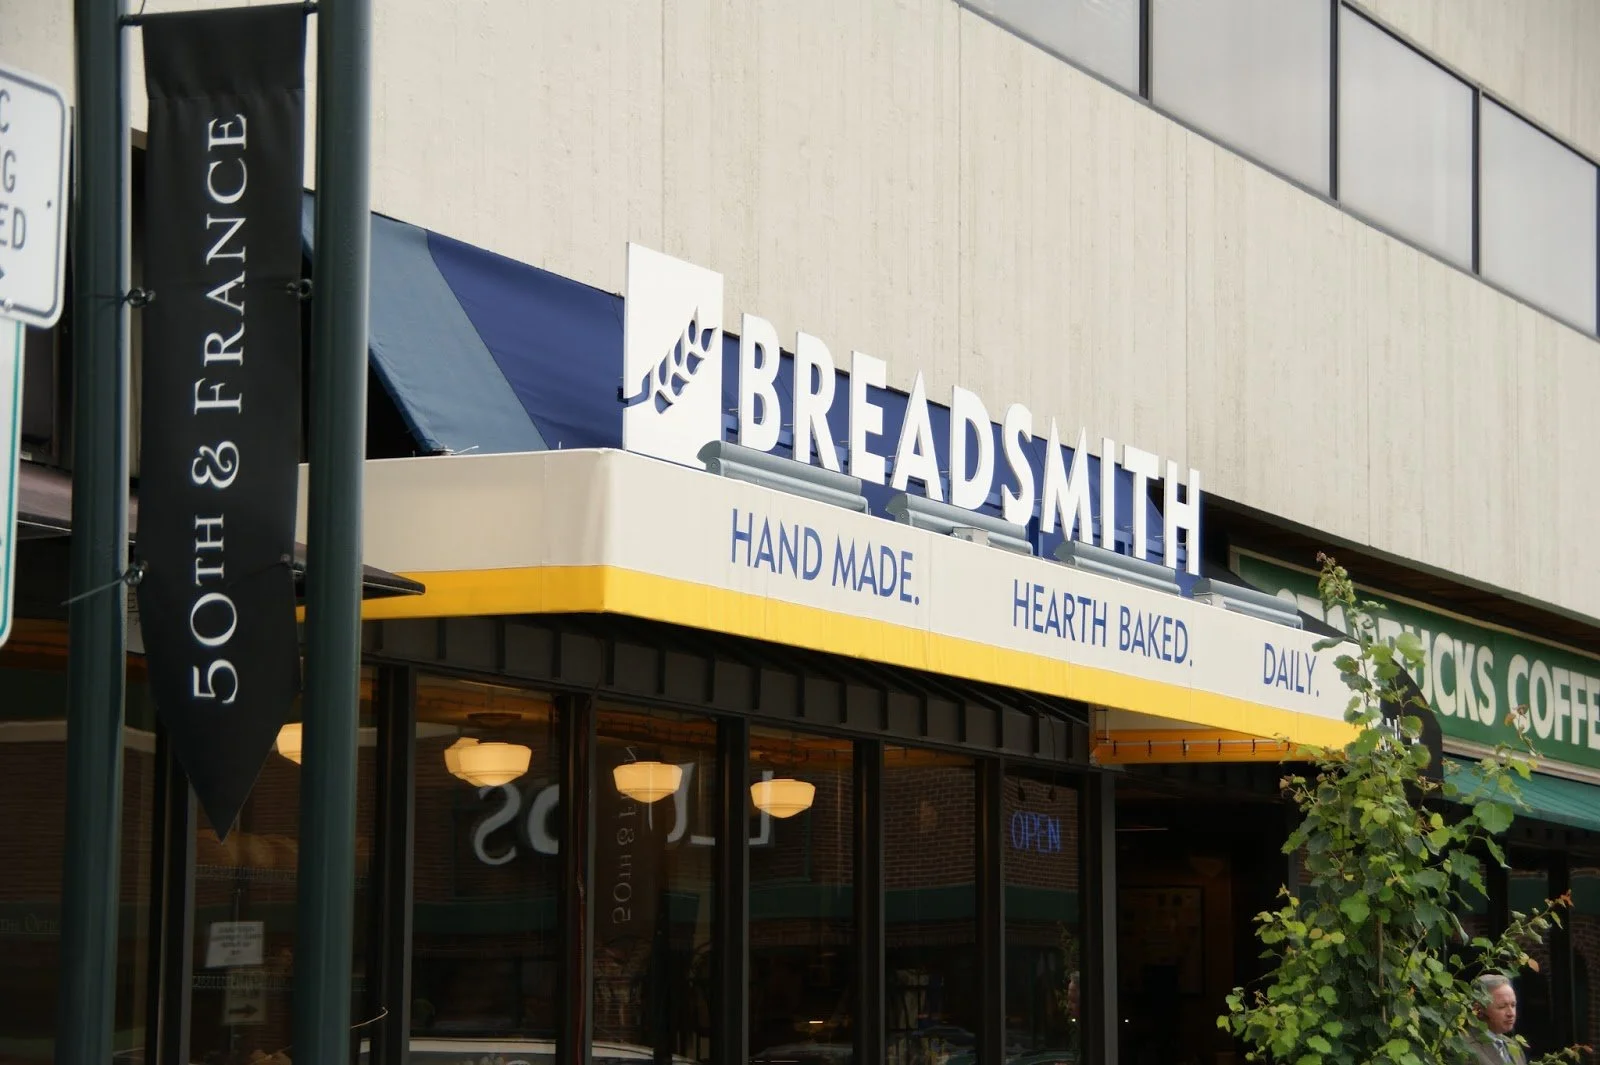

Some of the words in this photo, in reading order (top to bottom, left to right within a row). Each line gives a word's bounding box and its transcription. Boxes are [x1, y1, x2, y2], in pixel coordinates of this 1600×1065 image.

[194, 114, 247, 415] FRANCE
[192, 440, 240, 489] &
[738, 312, 1200, 576] BREADSMITH
[190, 514, 238, 704] 50TH
[731, 508, 823, 580] HAND
[832, 533, 920, 605] MADE.
[1013, 579, 1107, 648] HEARTH
[1119, 605, 1193, 667] BAKED.
[1263, 642, 1320, 697] DAILY.
[1011, 811, 1060, 852] OPEN
